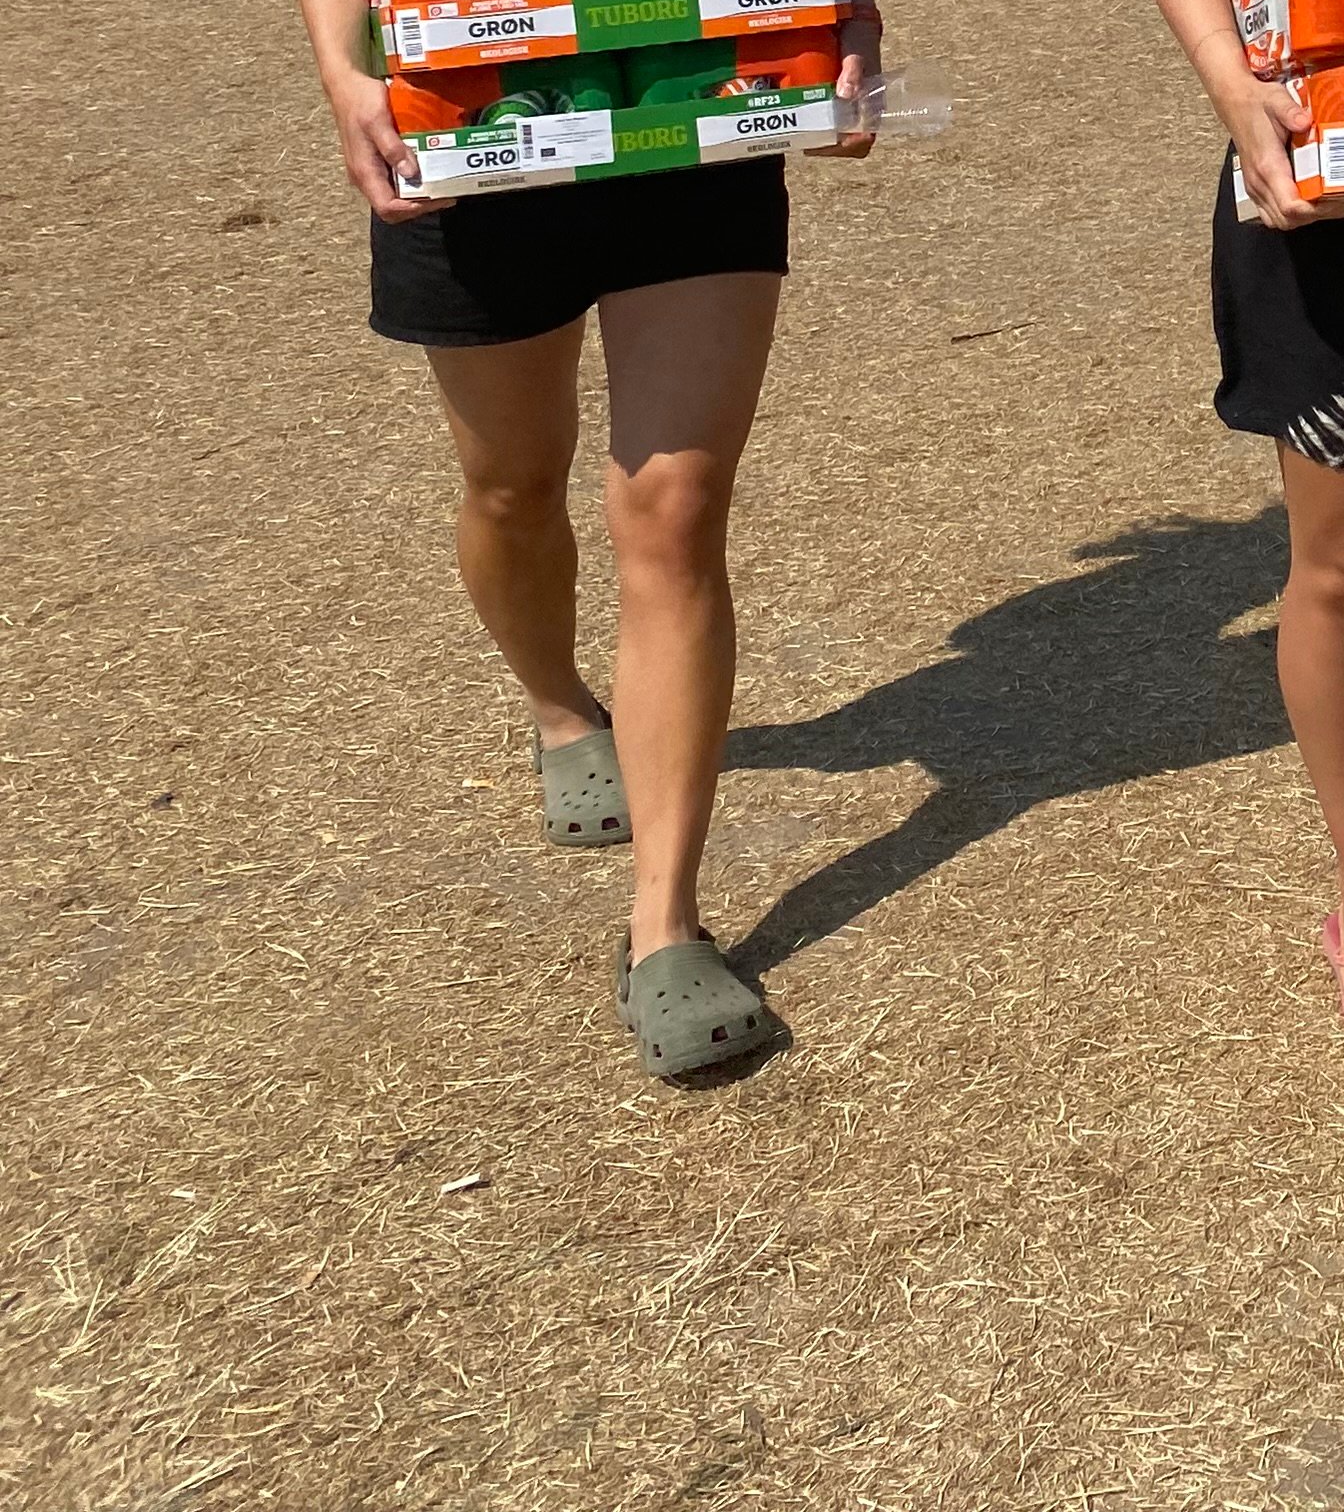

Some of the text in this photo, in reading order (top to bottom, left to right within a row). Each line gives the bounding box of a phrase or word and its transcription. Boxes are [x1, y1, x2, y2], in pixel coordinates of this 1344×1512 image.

[467, 16, 536, 39] GRØN
[736, 112, 798, 135] GRØN
[466, 148, 520, 169] GRØ
